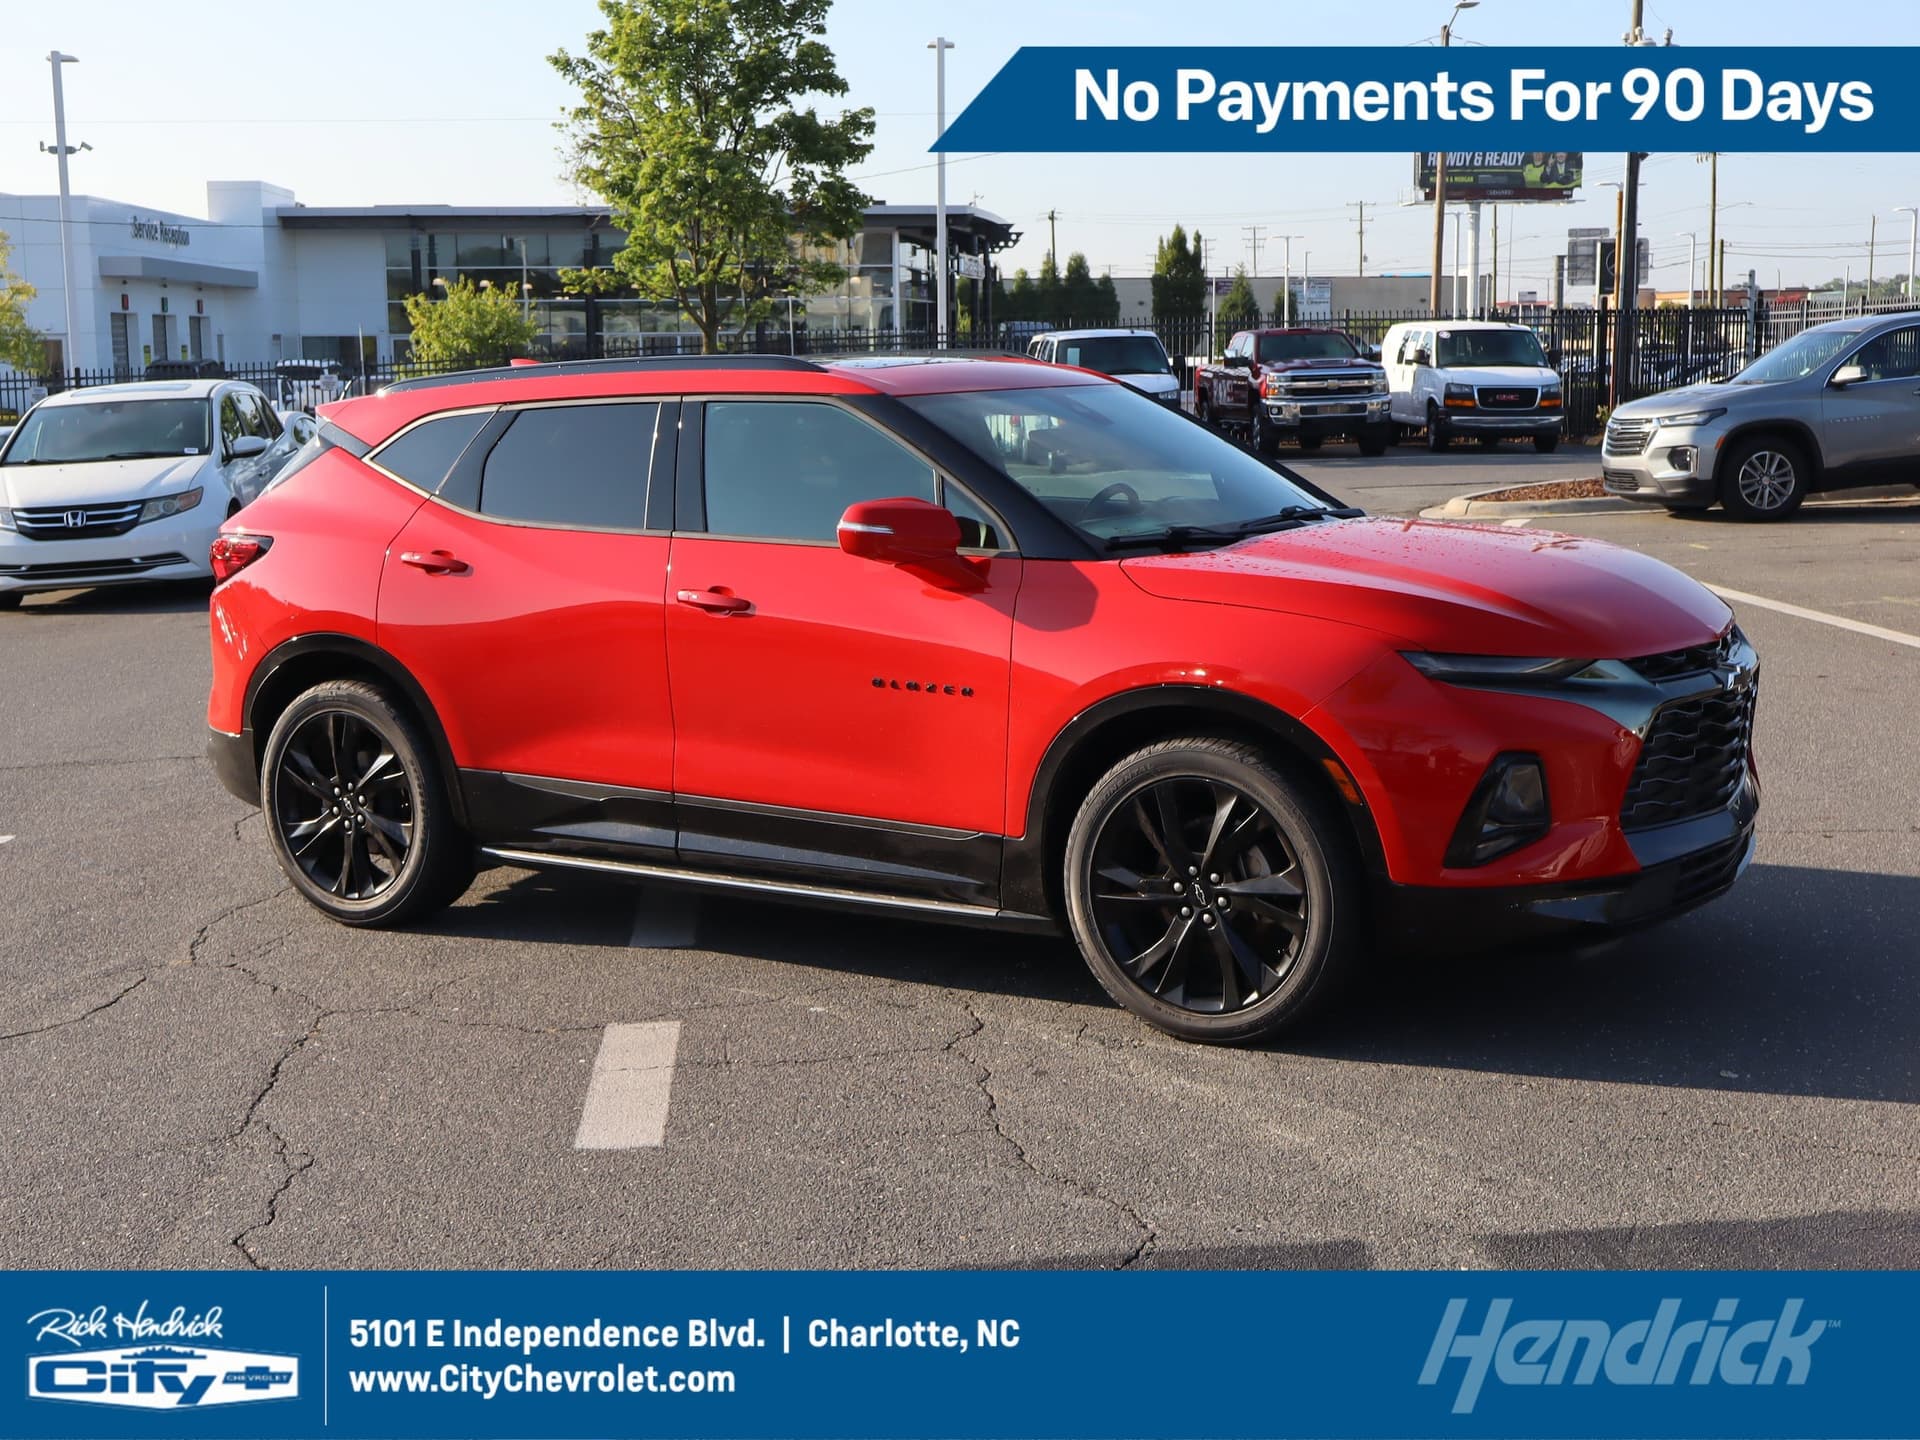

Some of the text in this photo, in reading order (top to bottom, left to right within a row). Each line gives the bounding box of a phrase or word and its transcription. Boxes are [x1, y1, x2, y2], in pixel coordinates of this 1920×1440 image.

[1427, 152, 1474, 166] RWDY
[1484, 152, 1525, 166] READY
[132, 215, 190, 247] Service Reception
[871, 677, 974, 698] BLAZER
